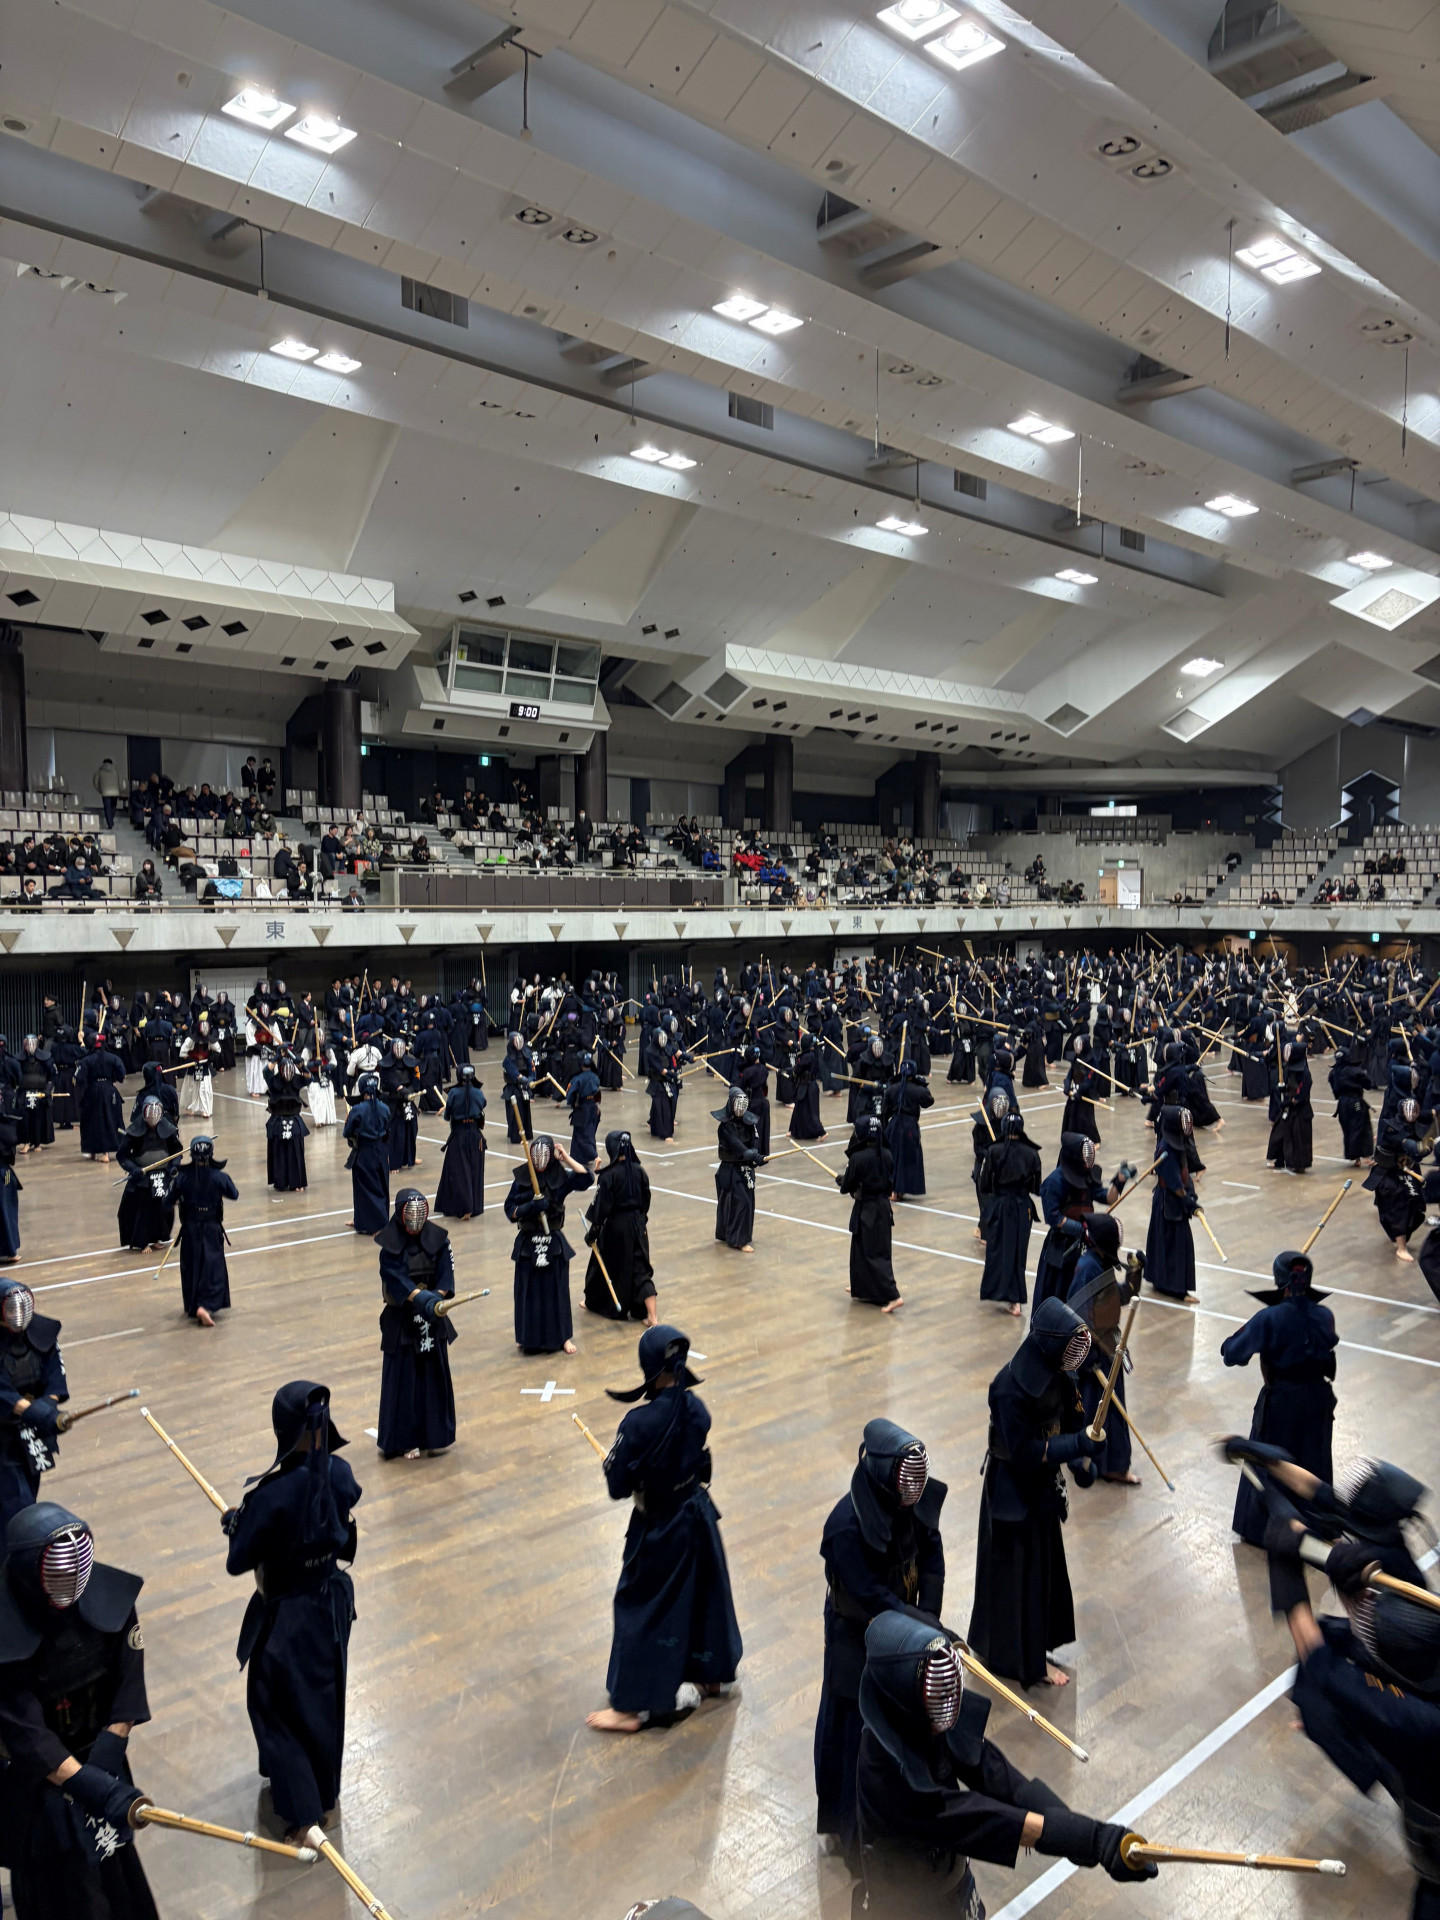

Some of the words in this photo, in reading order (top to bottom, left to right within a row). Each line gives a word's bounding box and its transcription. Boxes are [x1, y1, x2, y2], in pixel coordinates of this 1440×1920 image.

[518, 705, 537, 718] 9:00
[853, 915, 863, 929] 東
[265, 920, 286, 940] 東
